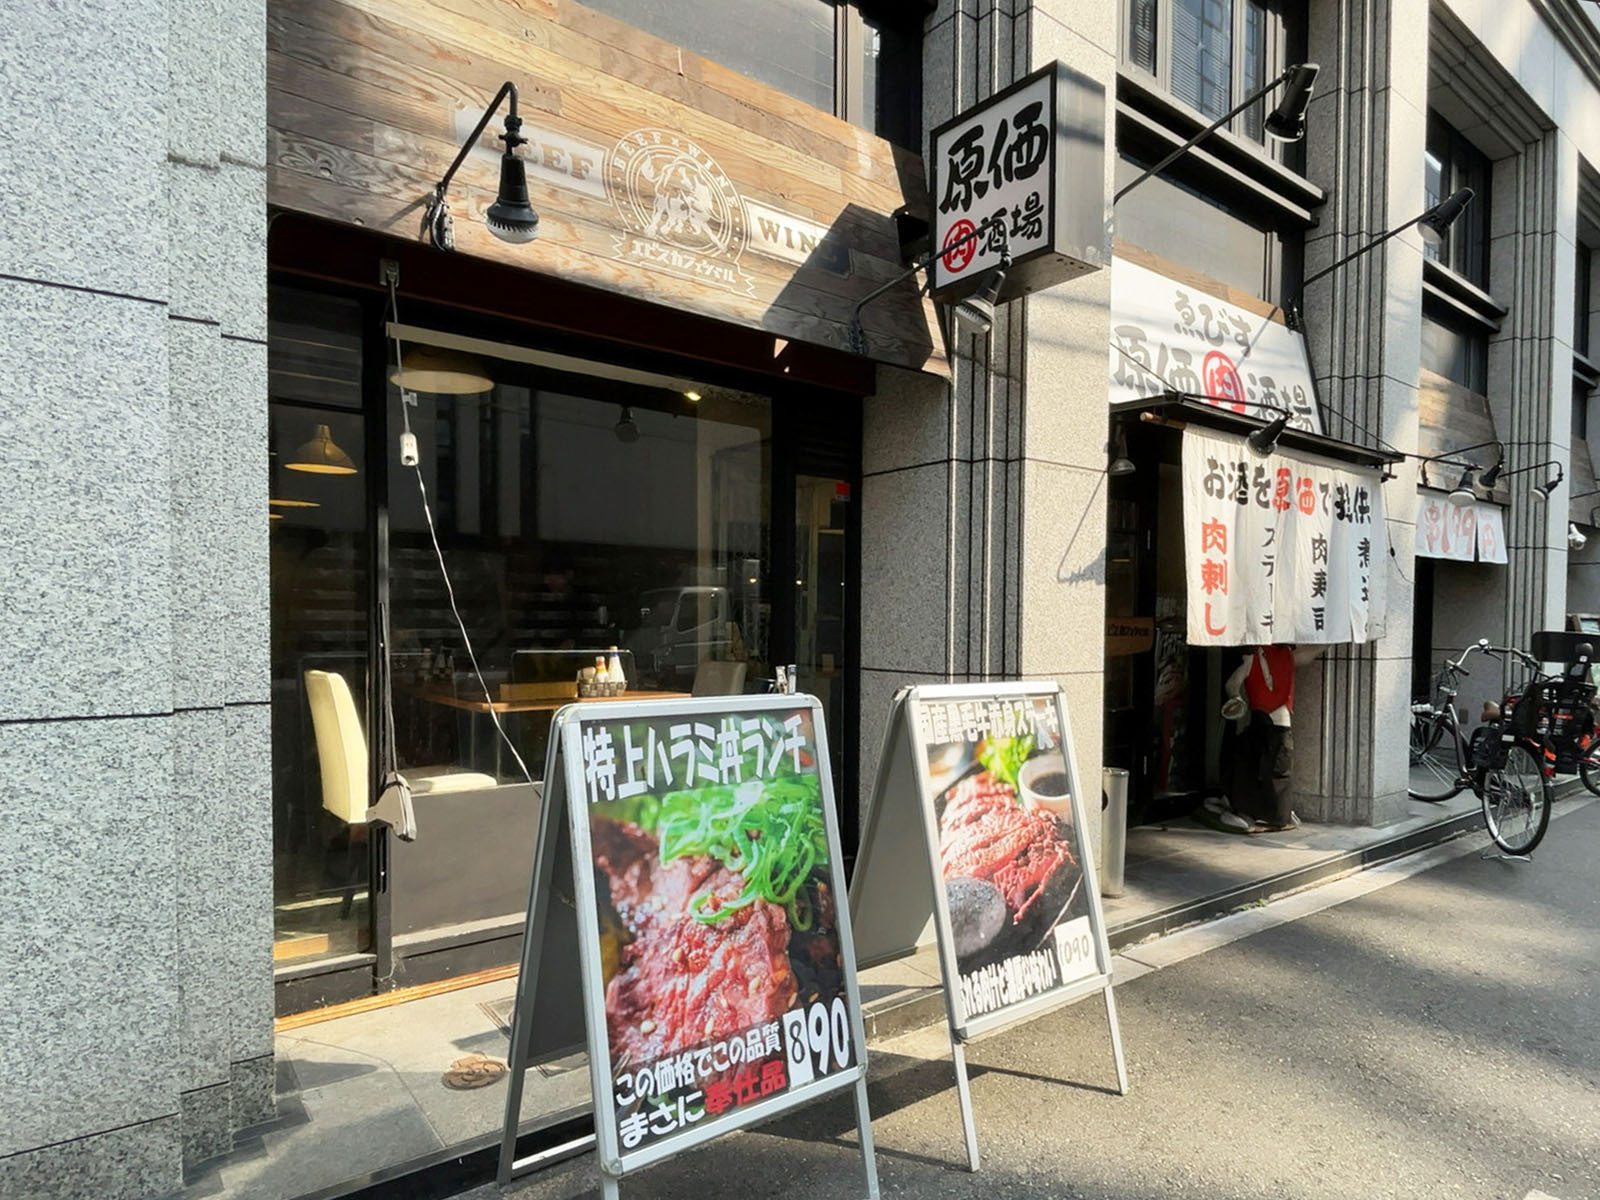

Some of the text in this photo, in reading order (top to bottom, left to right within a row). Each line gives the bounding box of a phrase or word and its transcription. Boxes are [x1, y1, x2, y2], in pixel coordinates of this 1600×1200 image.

[939, 101, 1049, 215] 原価
[1201, 516, 1228, 636] 肉刺し
[583, 714, 807, 803] 特上ハラミ丼ランチ
[615, 1021, 782, 1106] この価格でこの品質
[789, 997, 850, 1075] 890
[619, 1059, 788, 1149] まさに奉仕品
